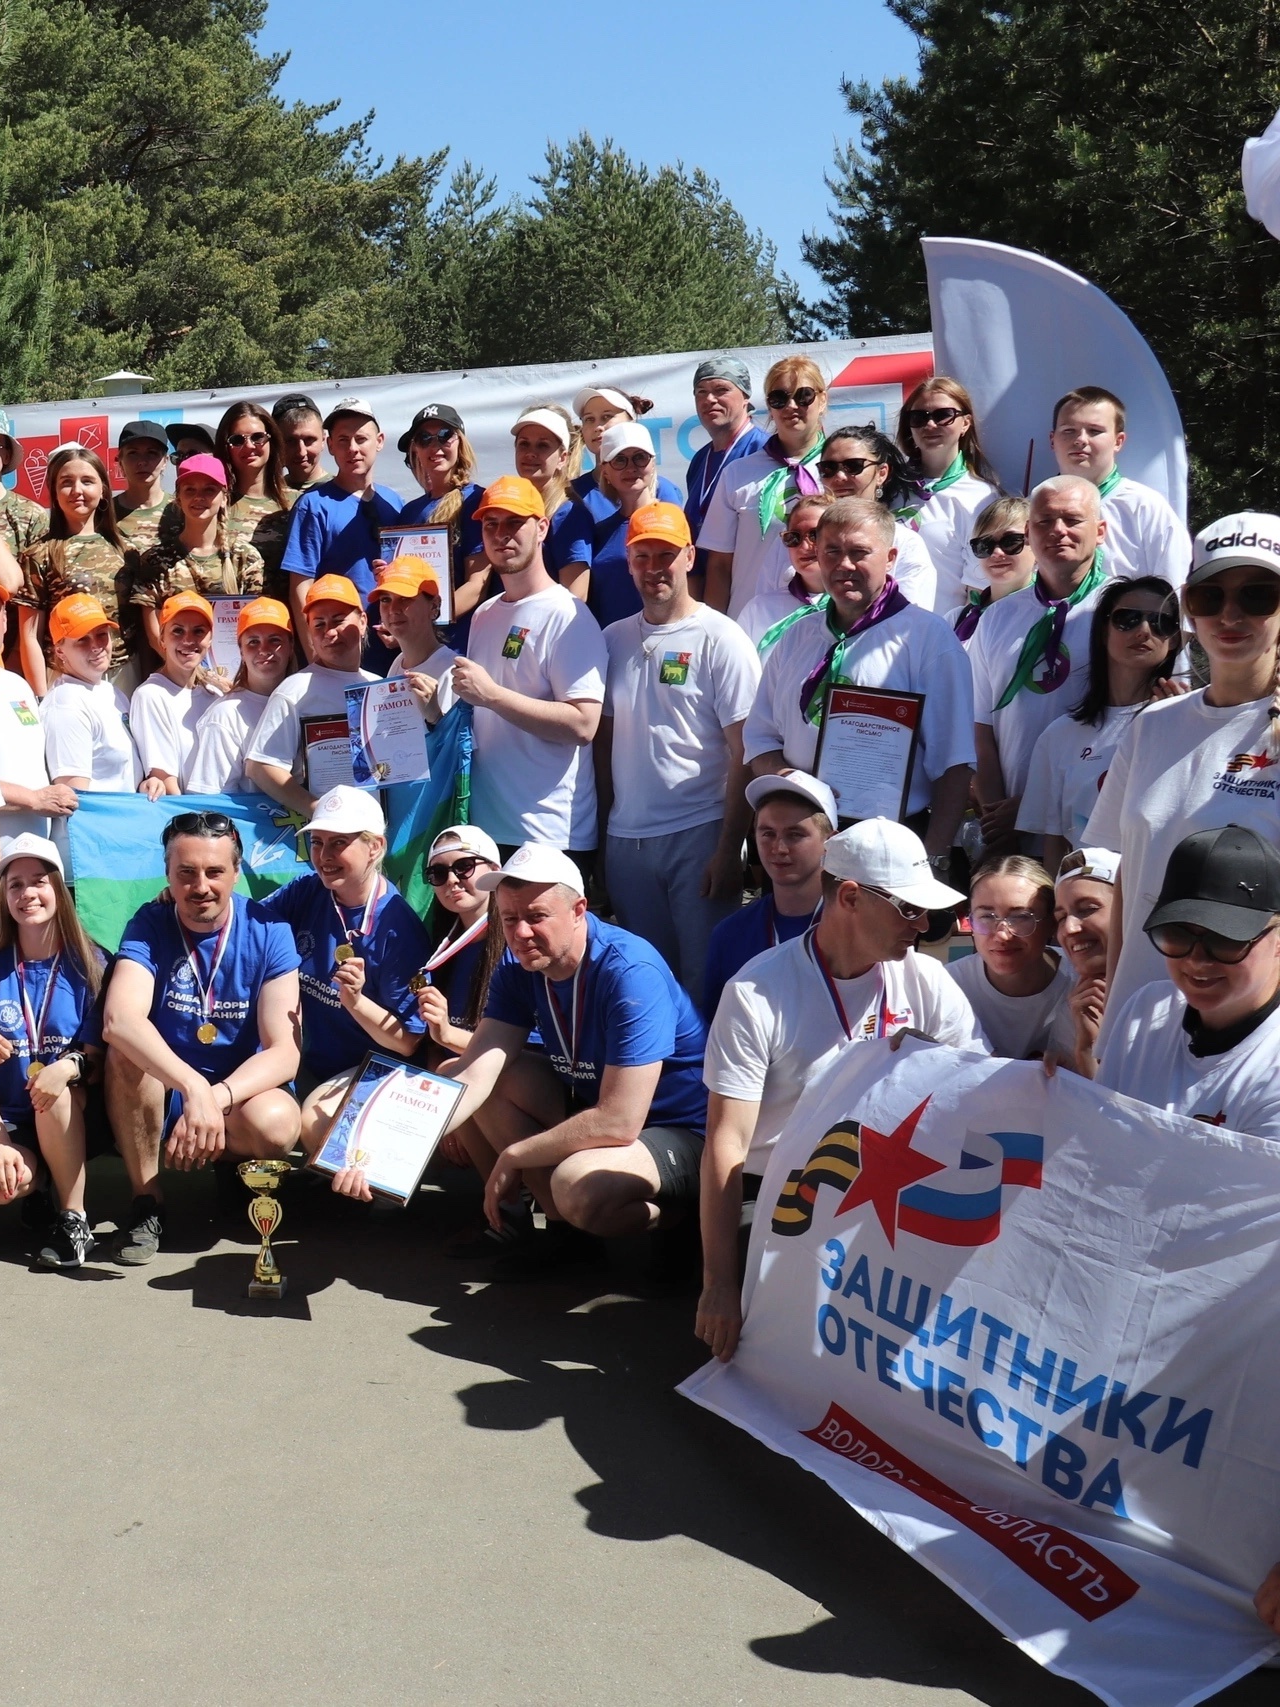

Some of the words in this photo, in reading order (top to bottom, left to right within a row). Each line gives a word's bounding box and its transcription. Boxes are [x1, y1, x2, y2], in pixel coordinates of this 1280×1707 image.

[1205, 532, 1280, 556] adidas
[217, 616, 239, 624] ГРАМ
[373, 699, 414, 712] ГРАМОТА
[840, 719, 901, 733] БЛАГОДАРСТВЕННОЕ
[856, 728, 882, 737] ПИСЬМО
[1213, 782, 1275, 800] ОТЕЧЕСТВА
[166, 990, 249, 1010] АМБАДОРЫ
[389, 1091, 439, 1115] ГРАМОТА
[821, 1239, 1213, 1469] ЗАЩИТНИКИ
[818, 1304, 1133, 1520] ОТЕЧЕСТВА
